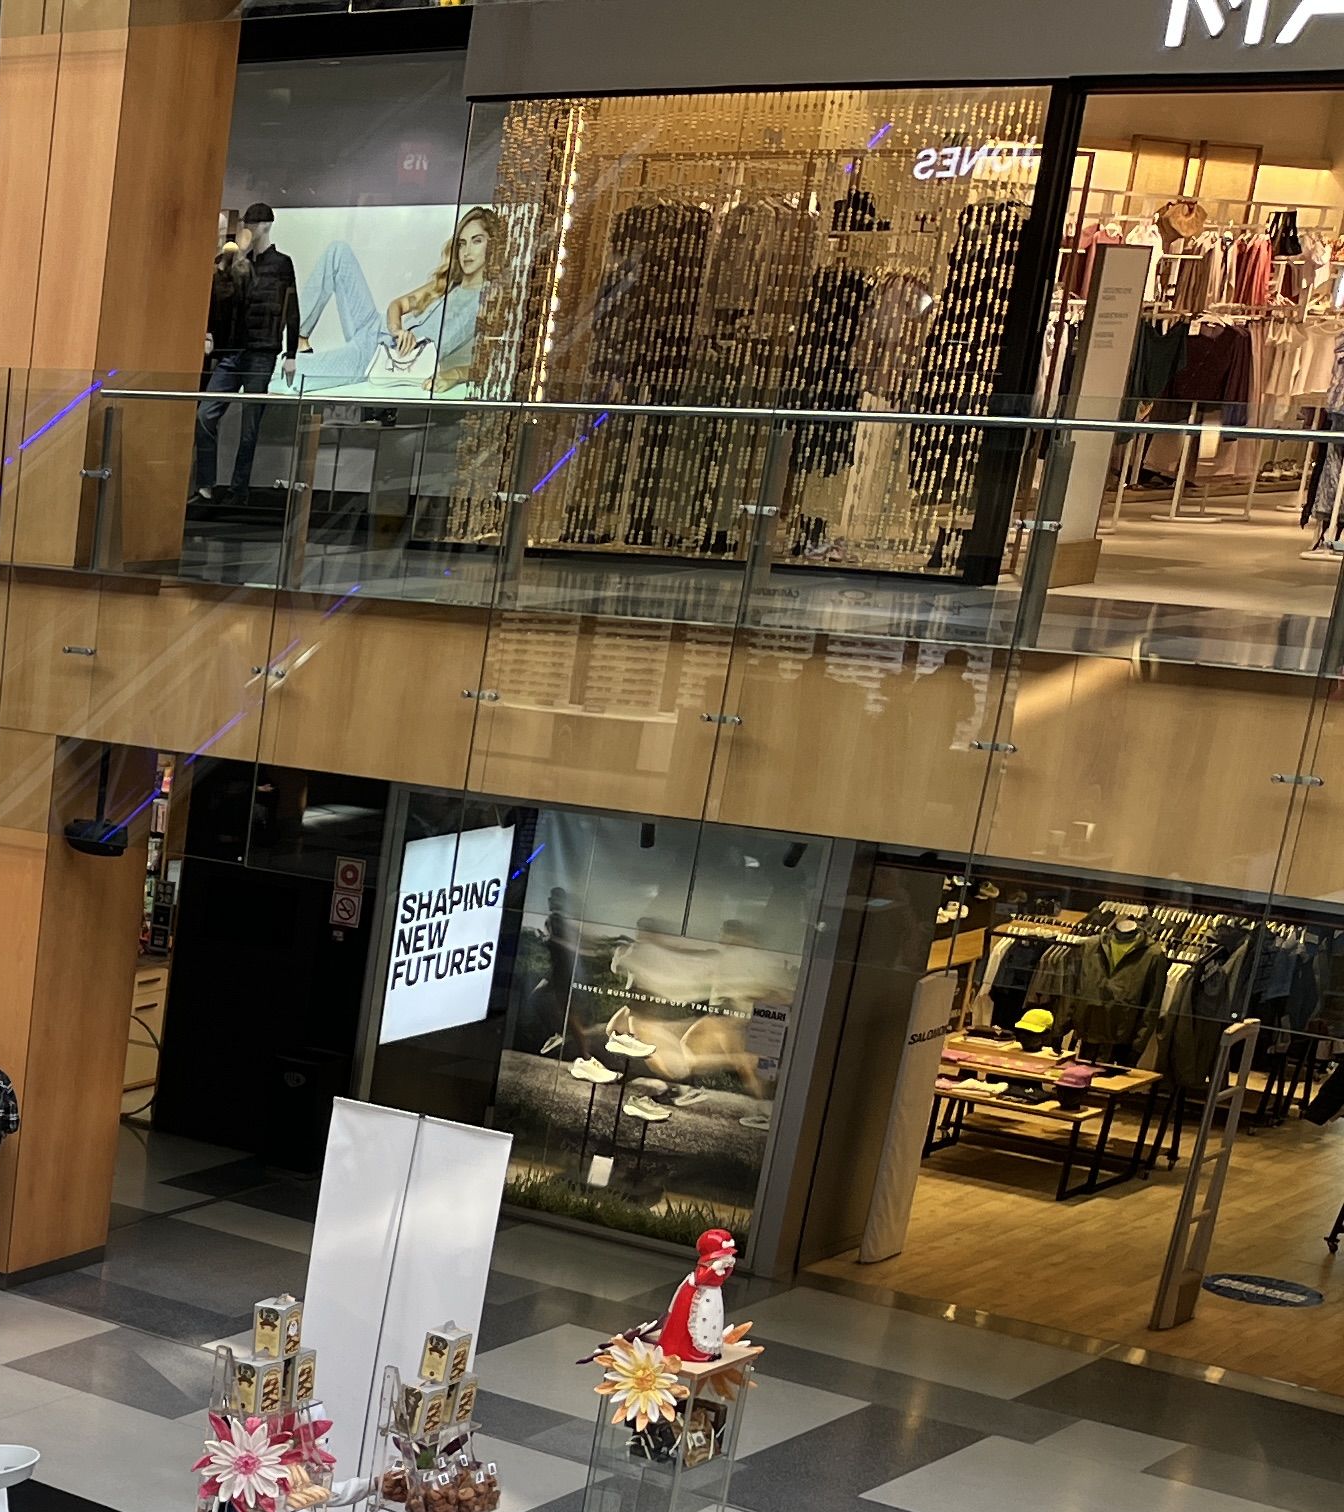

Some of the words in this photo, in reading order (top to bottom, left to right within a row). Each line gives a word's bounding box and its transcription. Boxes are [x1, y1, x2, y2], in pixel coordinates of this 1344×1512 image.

[399, 877, 502, 925] SHAPING
[395, 919, 452, 958] NEW
[389, 941, 495, 991] FUTURES
[607, 989, 647, 1002] RUNNING
[648, 995, 668, 1005] FOR
[670, 998, 689, 1008] OFF
[690, 1002, 720, 1016] TRACK
[752, 1007, 788, 1022] HORARI
